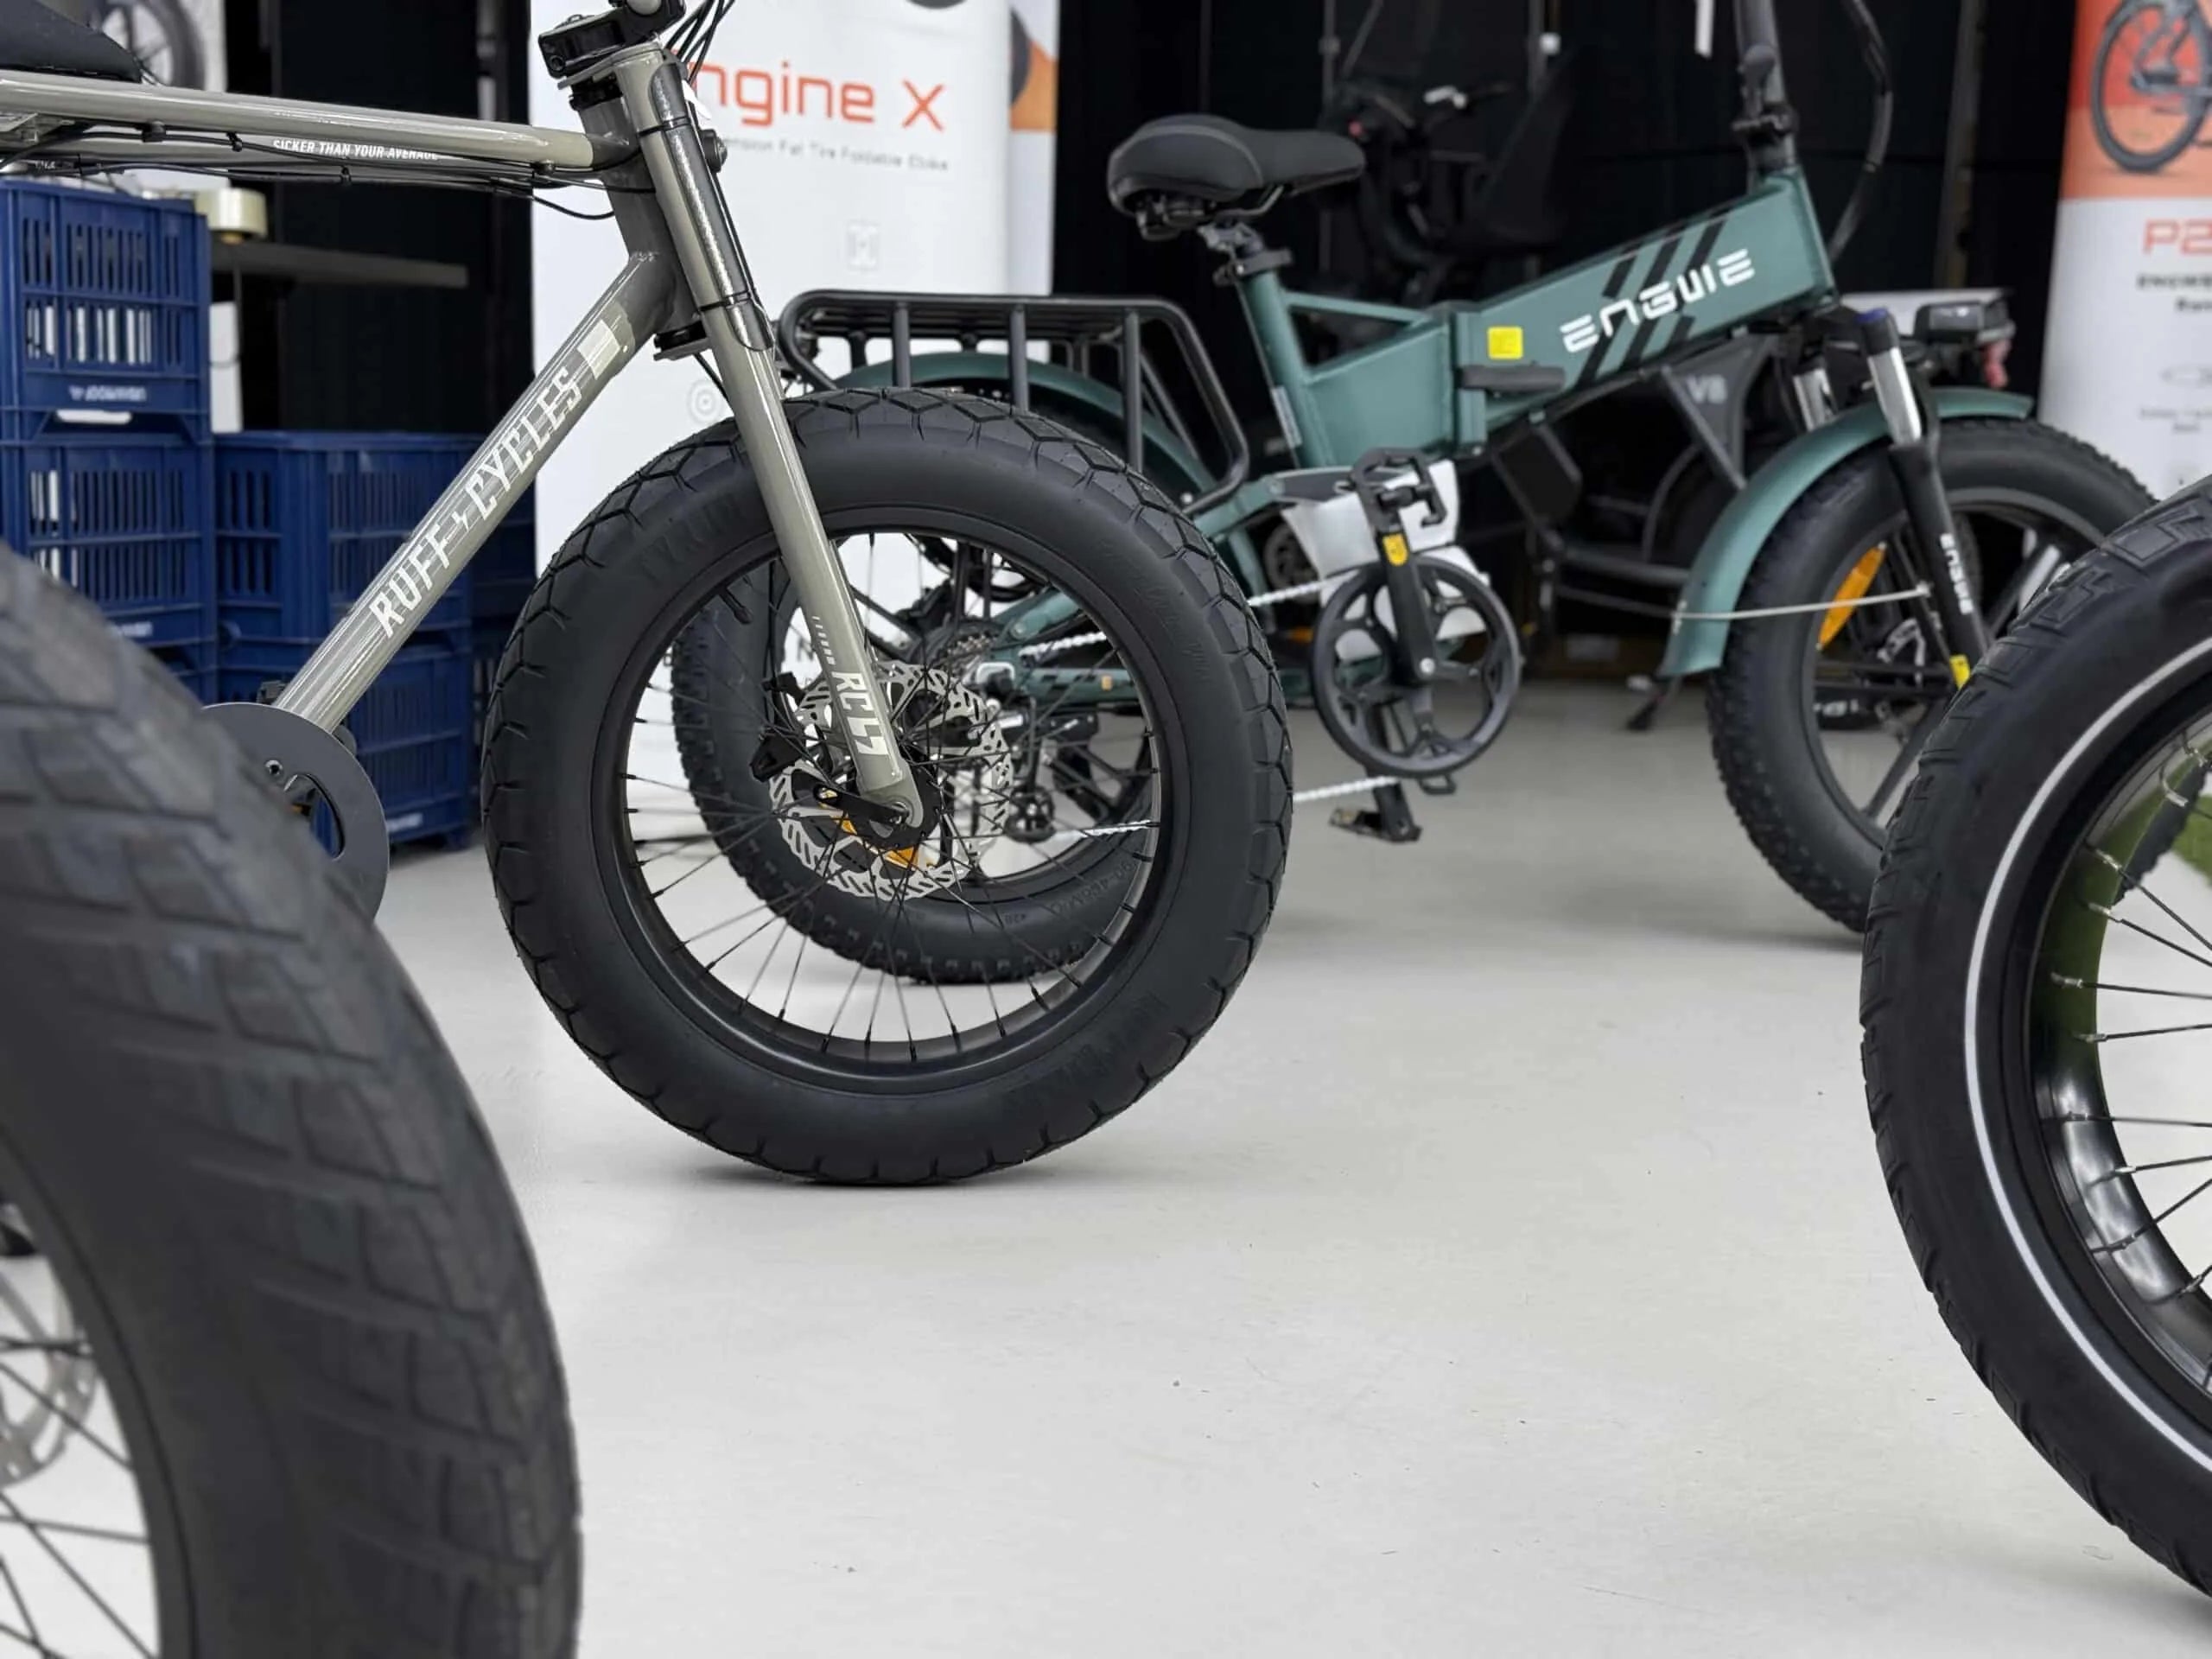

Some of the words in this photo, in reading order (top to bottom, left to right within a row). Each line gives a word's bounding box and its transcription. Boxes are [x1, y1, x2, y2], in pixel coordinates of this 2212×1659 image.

[687, 59, 875, 127] ngine
[901, 79, 944, 131] X
[273, 138, 315, 154] SICKER
[319, 141, 351, 158] THAN
[353, 143, 385, 159] YOUR
[368, 524, 450, 638] RUFF
[465, 365, 582, 521] CYCLES
